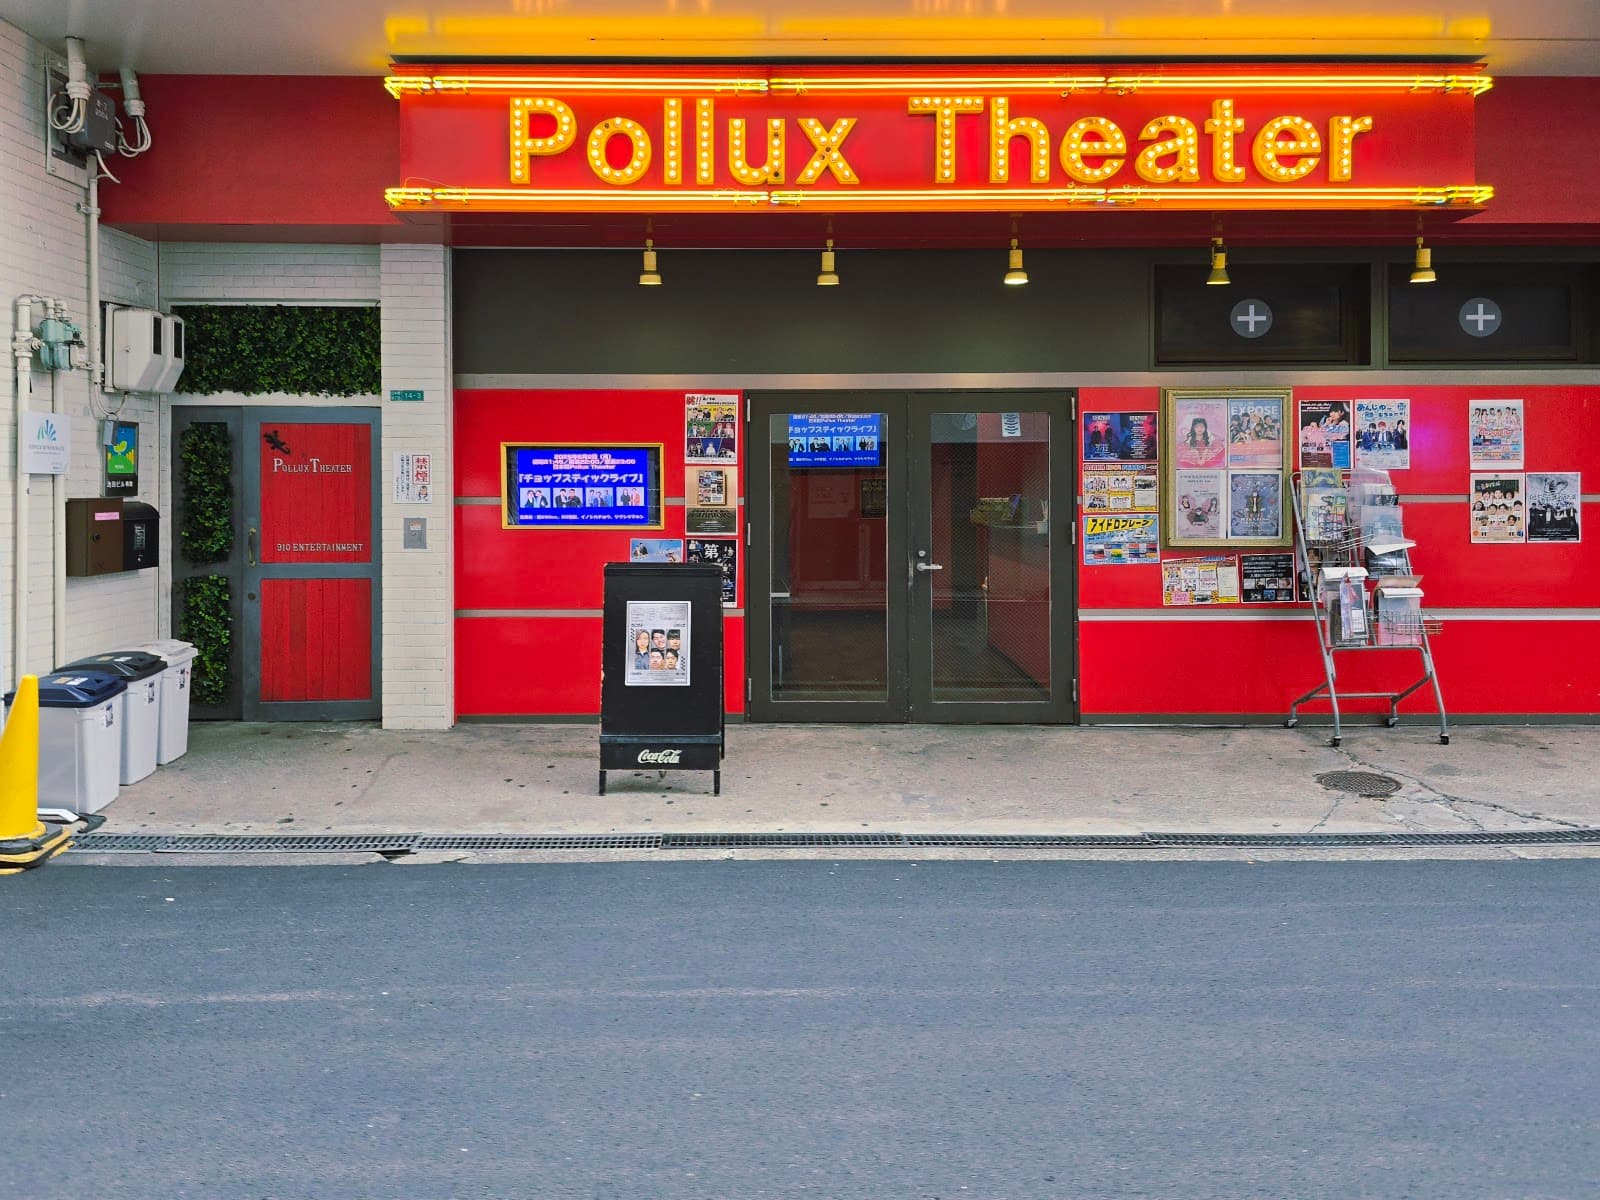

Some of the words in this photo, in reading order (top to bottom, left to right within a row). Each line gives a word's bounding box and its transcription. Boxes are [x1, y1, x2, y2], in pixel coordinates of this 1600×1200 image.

[510, 97, 860, 185] Pollux
[908, 96, 1373, 184] Theater
[1231, 406, 1279, 416] EXPOSE
[310, 458, 352, 473] THEATER
[415, 456, 429, 483] 禁煙
[293, 543, 363, 552] ENTERTAINMENT
[703, 543, 720, 559] 第
